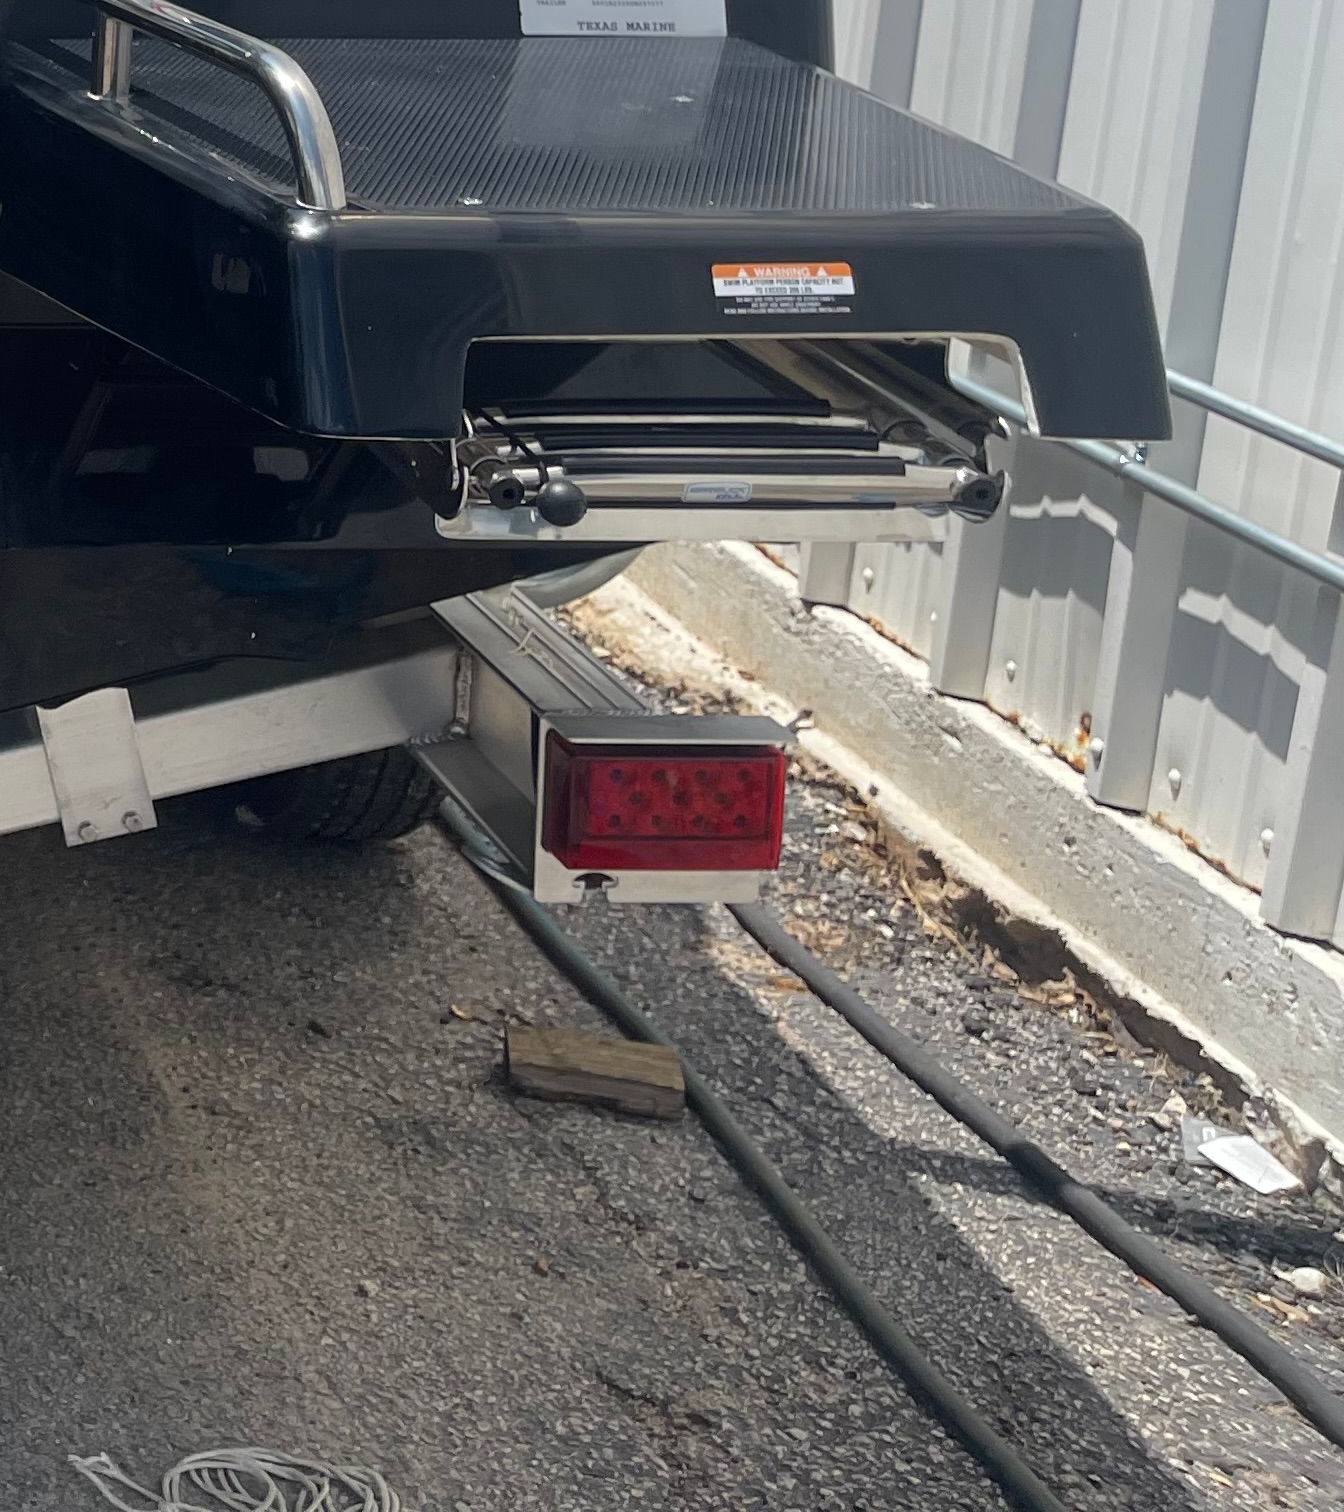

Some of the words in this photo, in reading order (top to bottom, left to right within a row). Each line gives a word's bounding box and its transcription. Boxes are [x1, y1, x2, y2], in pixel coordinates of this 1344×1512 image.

[576, 20, 619, 33] TEXAS
[626, 21, 677, 33] MARINE
[753, 265, 811, 278] WARNING
